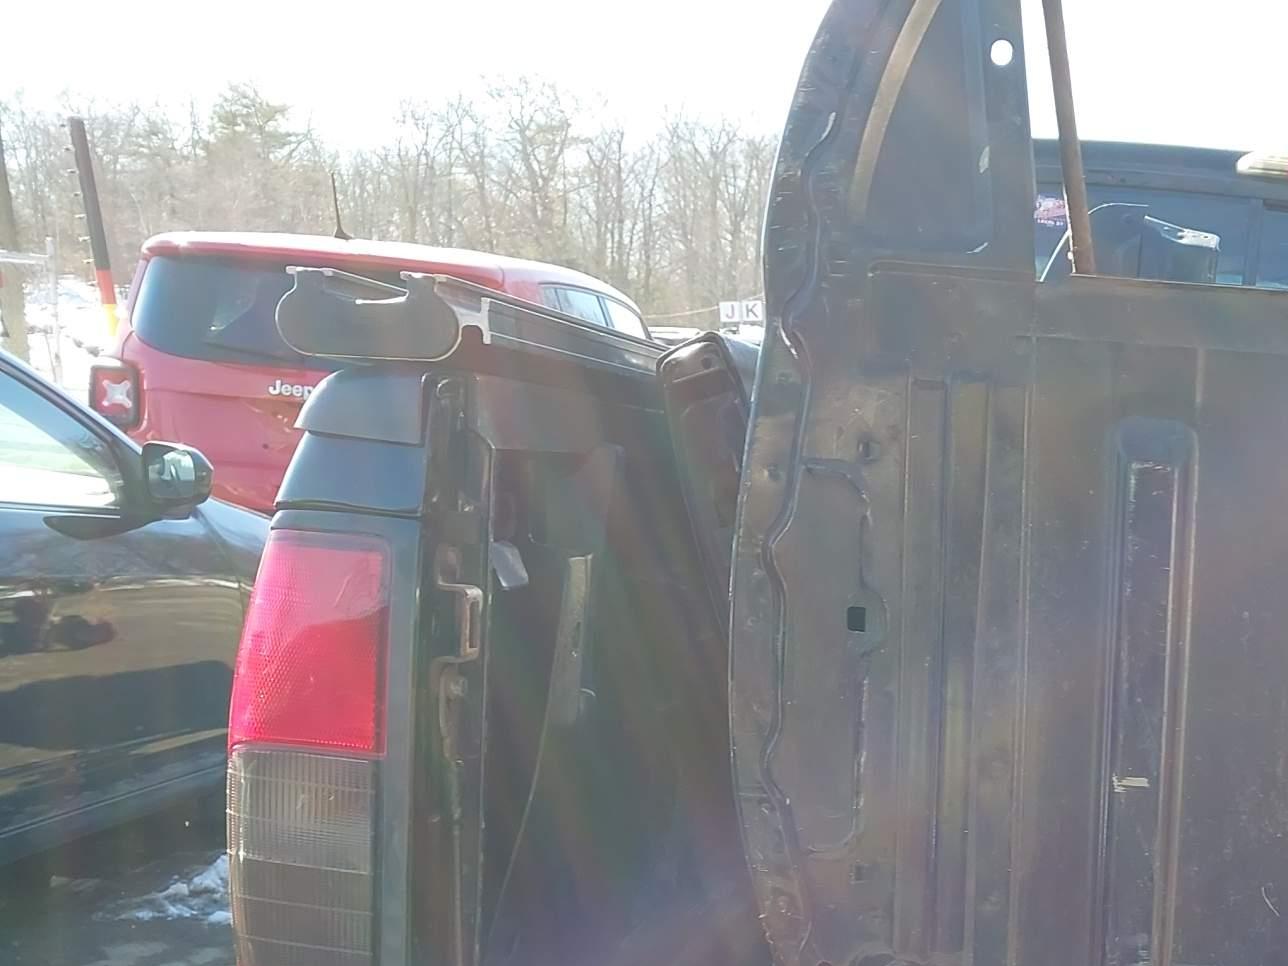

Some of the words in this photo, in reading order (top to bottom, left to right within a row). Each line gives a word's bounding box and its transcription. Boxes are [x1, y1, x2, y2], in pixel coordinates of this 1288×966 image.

[725, 303, 736, 319] J
[745, 303, 759, 319] K
[268, 379, 314, 401] Jeep
